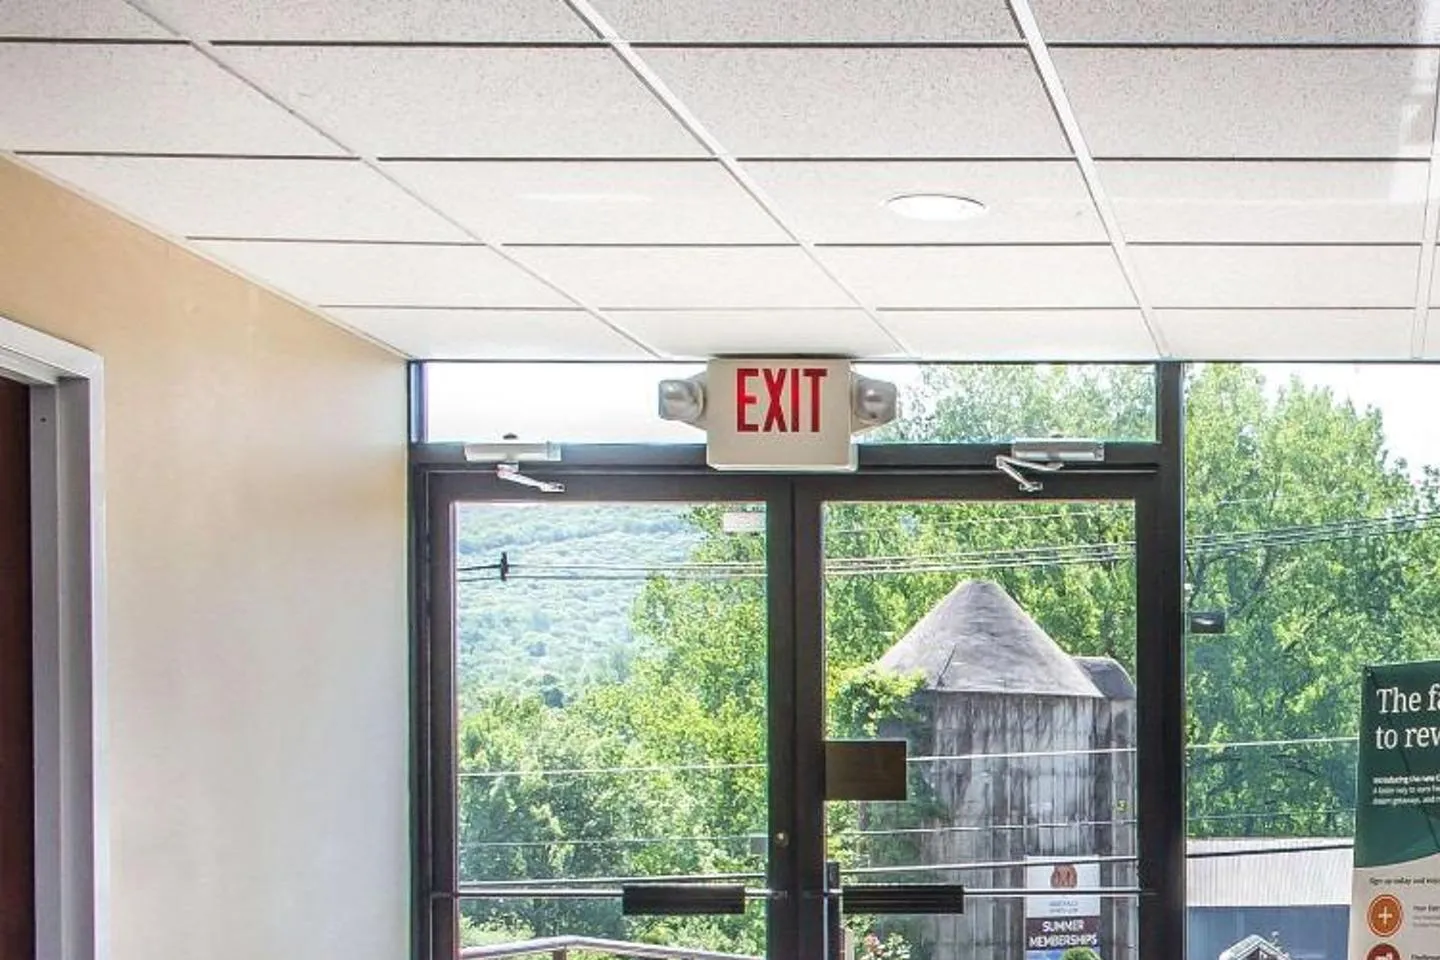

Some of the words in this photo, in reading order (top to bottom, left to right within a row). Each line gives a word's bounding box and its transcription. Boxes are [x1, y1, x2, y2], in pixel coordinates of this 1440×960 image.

[736, 368, 828, 432] EXIT
[1376, 687, 1422, 714] The
[1375, 725, 1398, 749] to
[1042, 920, 1084, 932] SUMMER
[1029, 933, 1097, 948] MEMBERSHIPS
